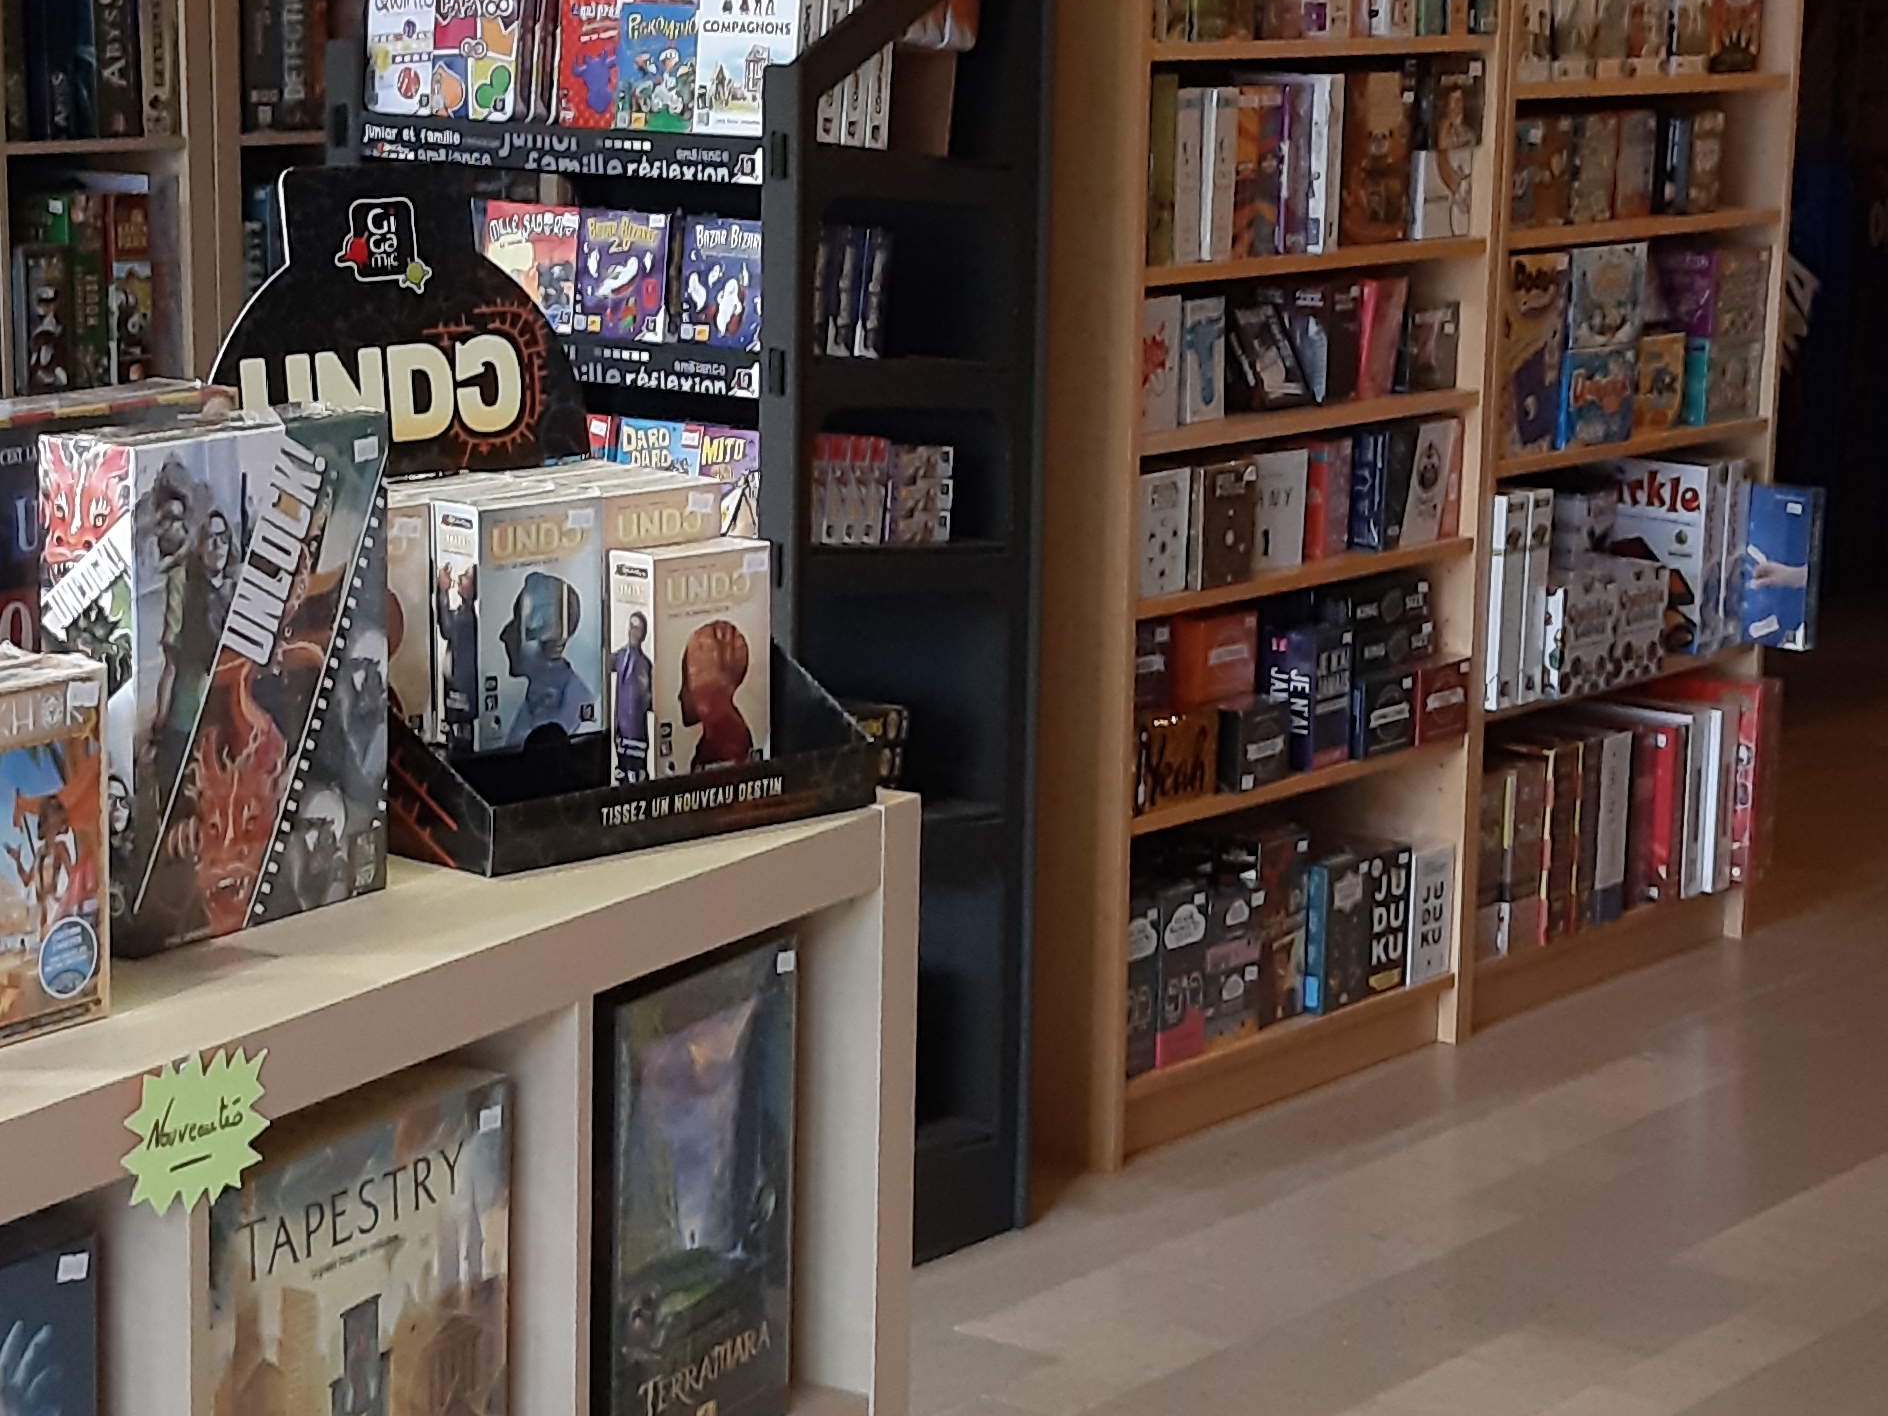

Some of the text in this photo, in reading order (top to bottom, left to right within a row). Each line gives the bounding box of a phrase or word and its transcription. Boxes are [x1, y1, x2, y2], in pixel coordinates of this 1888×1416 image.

[702, 19, 792, 35] COMPAGNONS
[626, 154, 730, 182] réflexion
[625, 366, 727, 396] réflexion
[621, 424, 671, 452] DARD
[701, 436, 747, 465] MITO
[222, 435, 327, 666] UNLOCK!
[44, 533, 130, 629] UNLOCK!
[600, 775, 784, 827] TISSEZ UN NOUVEAU DESTIN
[1373, 867, 1407, 903] JU
[1421, 879, 1445, 905] JU
[1371, 899, 1405, 933] DU
[1420, 901, 1444, 927] DU
[1369, 933, 1404, 967] KU
[1418, 926, 1444, 951] KU
[236, 1137, 465, 1282] TAPESTRY
